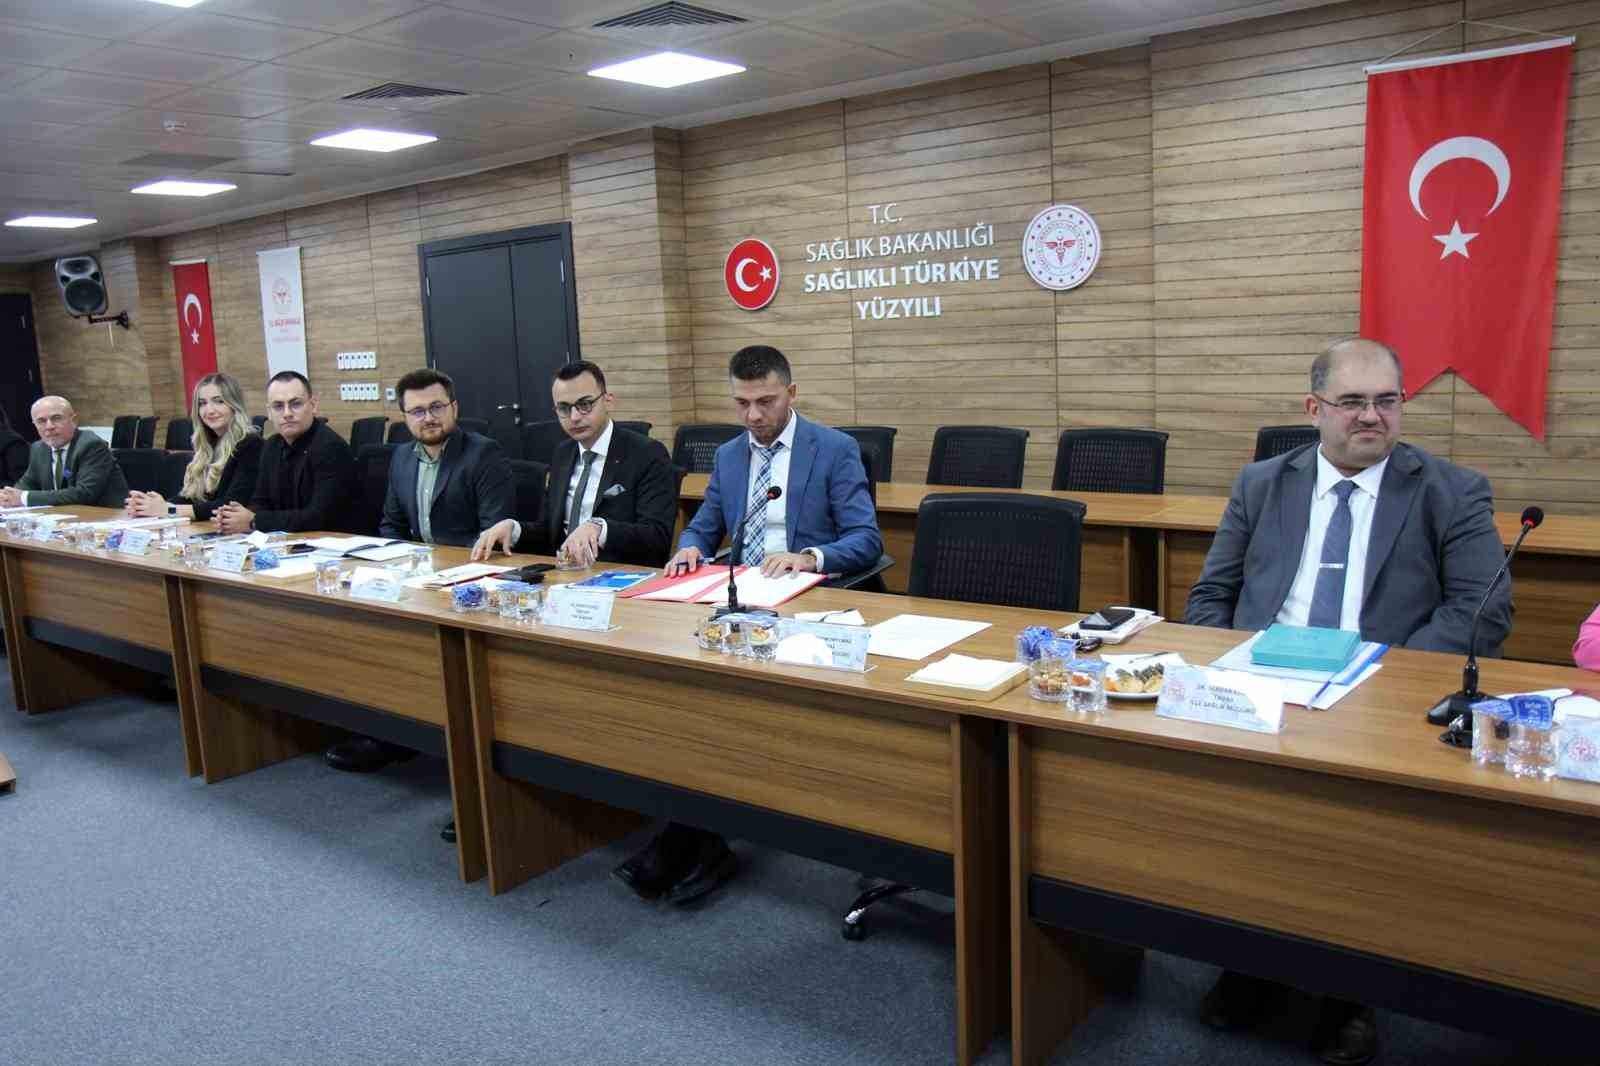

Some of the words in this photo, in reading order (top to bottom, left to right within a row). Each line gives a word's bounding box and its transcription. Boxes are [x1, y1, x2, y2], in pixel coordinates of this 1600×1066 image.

[866, 203, 902, 224] T.C.
[806, 237, 874, 263] SAĞLIK
[879, 222, 993, 256] BAKANLIĞI
[804, 267, 896, 293] SAĞLIKLI
[900, 256, 999, 285] TÜRKİYE
[855, 296, 941, 320] YÜZYILI
